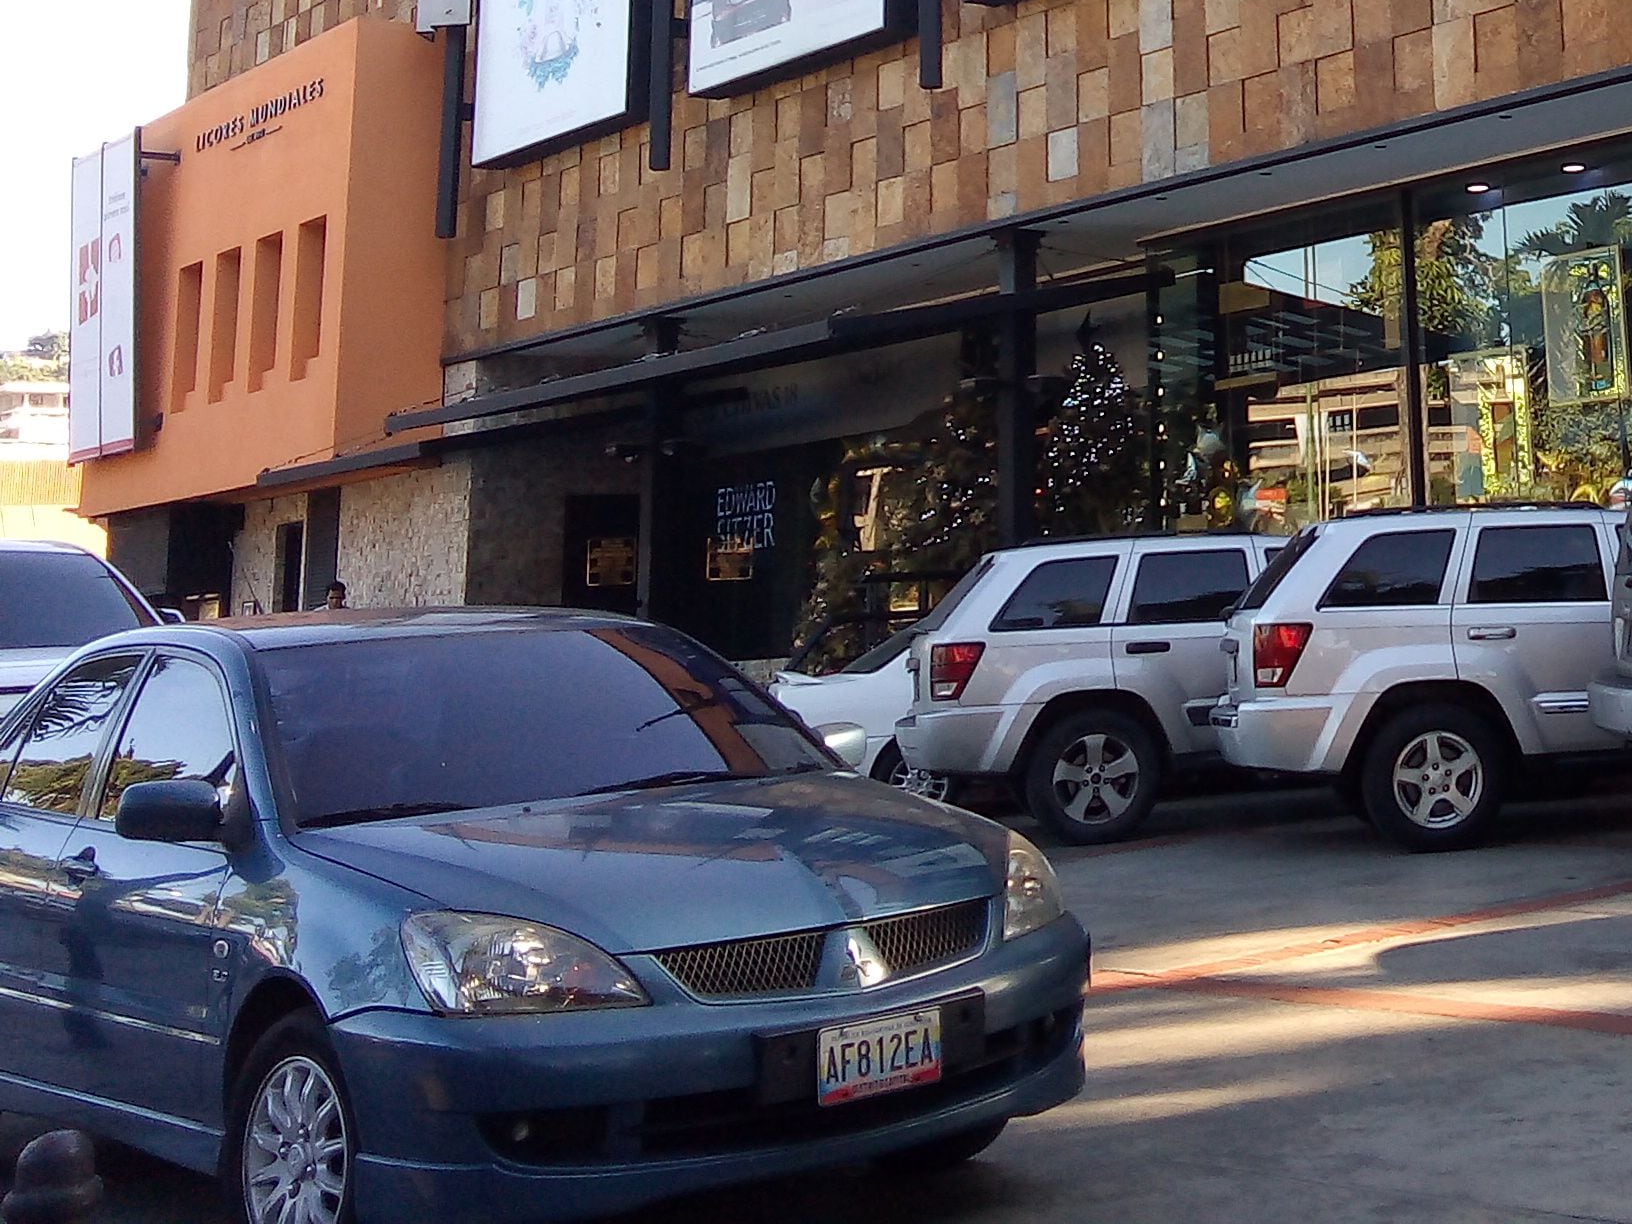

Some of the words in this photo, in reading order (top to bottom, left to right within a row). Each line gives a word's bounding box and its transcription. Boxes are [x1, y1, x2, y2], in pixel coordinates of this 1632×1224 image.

[195, 115, 245, 152] LICORES
[249, 78, 325, 128] MUNDIALES
[717, 480, 776, 516] EDWARD
[826, 1027, 933, 1085] AF812EA
